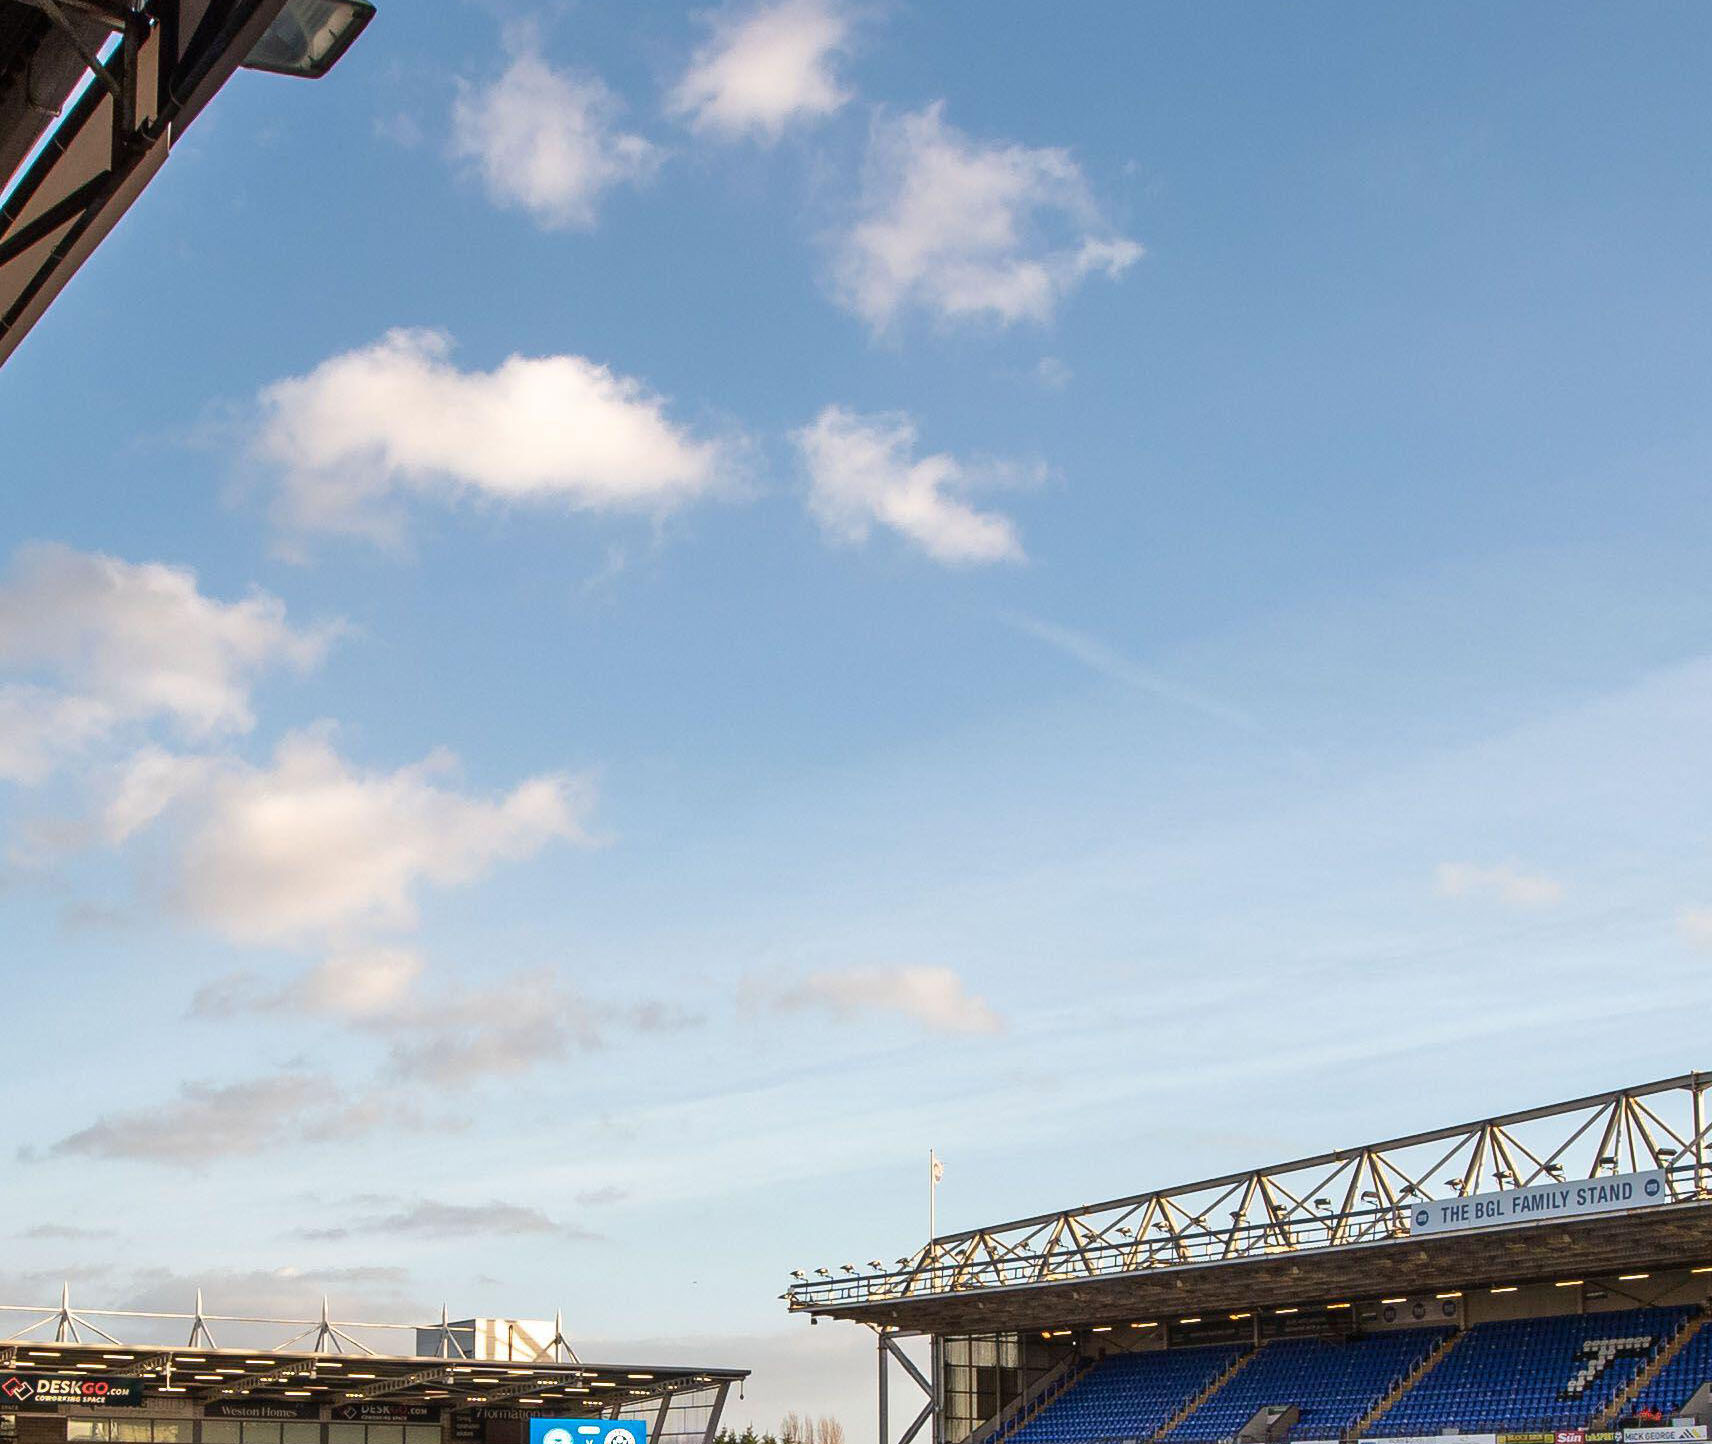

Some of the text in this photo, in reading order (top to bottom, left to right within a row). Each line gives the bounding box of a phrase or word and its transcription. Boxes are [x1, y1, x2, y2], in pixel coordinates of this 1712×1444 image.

[1440, 1182, 1633, 1225] THE BGL FAMILY STAND
[36, 1379, 130, 1396] DESKGO.COM
[82, 1395, 106, 1404] SPACE
[221, 1406, 298, 1418] Weston Homes
[1557, 1432, 1583, 1444] Sun
[1626, 1430, 1676, 1441] MICK GEORGE
